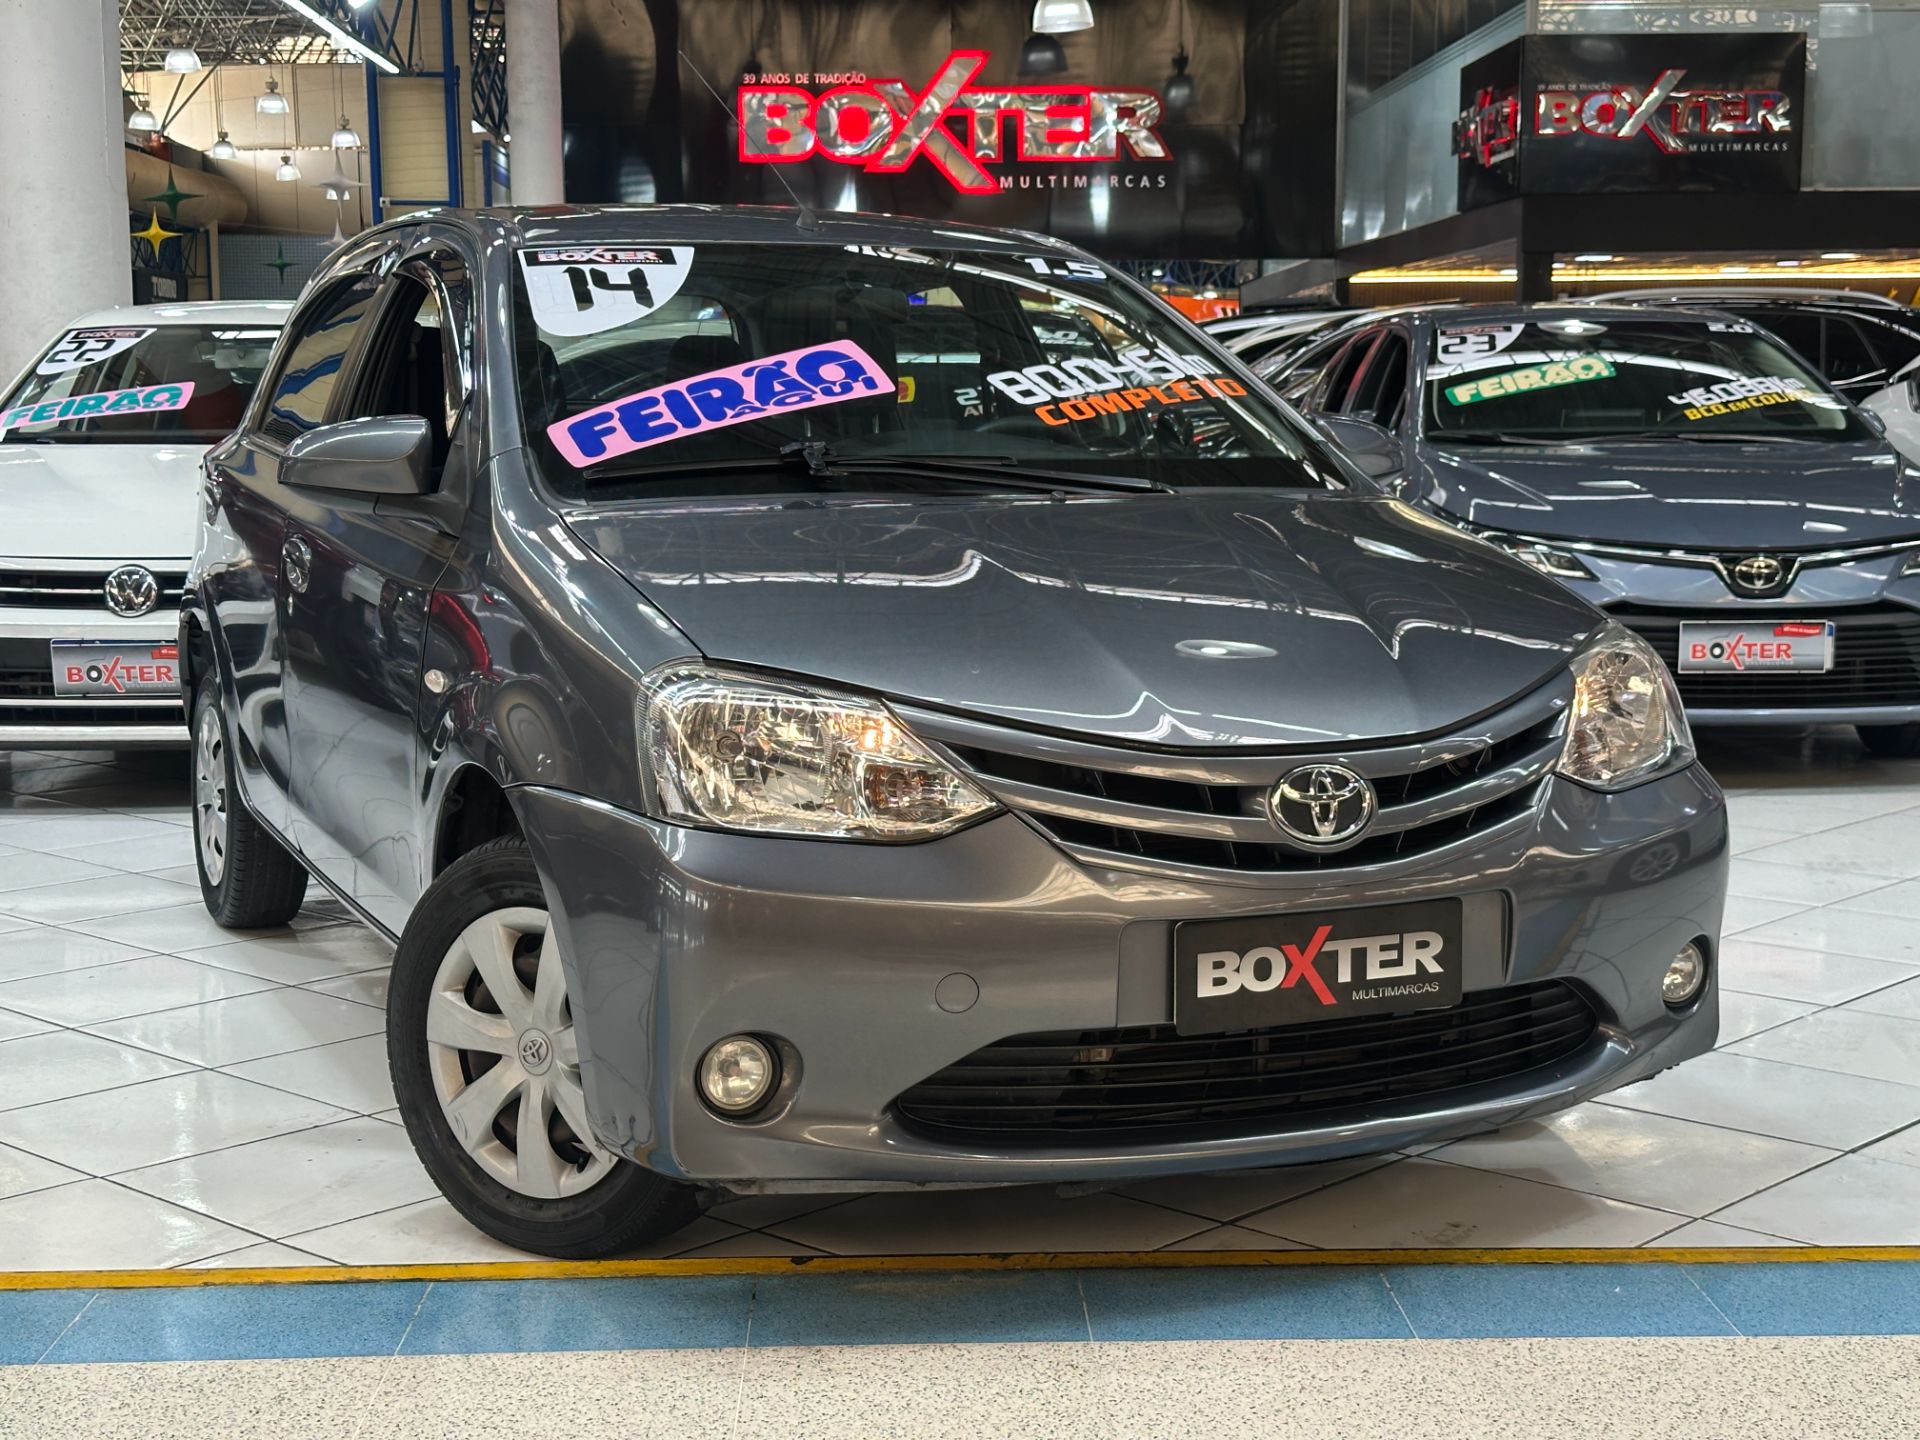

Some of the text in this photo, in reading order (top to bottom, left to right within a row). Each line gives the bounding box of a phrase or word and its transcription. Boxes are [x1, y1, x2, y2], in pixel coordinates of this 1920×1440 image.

[743, 71, 867, 86] 39 ANOS DE TRADIÇÃO
[738, 49, 1174, 194] BOXTER
[1534, 69, 1792, 154] BOXTER
[1688, 142, 1788, 152] MULTIMARCAS
[537, 248, 661, 263] BOXTER
[1025, 258, 1107, 279] 1.5
[562, 266, 655, 313] 14
[78, 330, 137, 339] BOXTER
[1441, 333, 1497, 354] 23
[1706, 322, 1754, 334] 2.0
[45, 339, 116, 363] 22
[730, 375, 879, 418] AQUI
[1454, 357, 1608, 403] FEIRÃO
[2, 385, 184, 427] FEIRÃO
[567, 350, 869, 458] FEIRÃO
[1034, 379, 1248, 426] COMPLETO
[1728, 400, 1751, 412] EM
[1690, 632, 1793, 670] BOXTER
[66, 656, 175, 692] BOXTER
[1197, 925, 1444, 1006] BOXTER
[1352, 981, 1439, 1000] MULTIMARCAS
